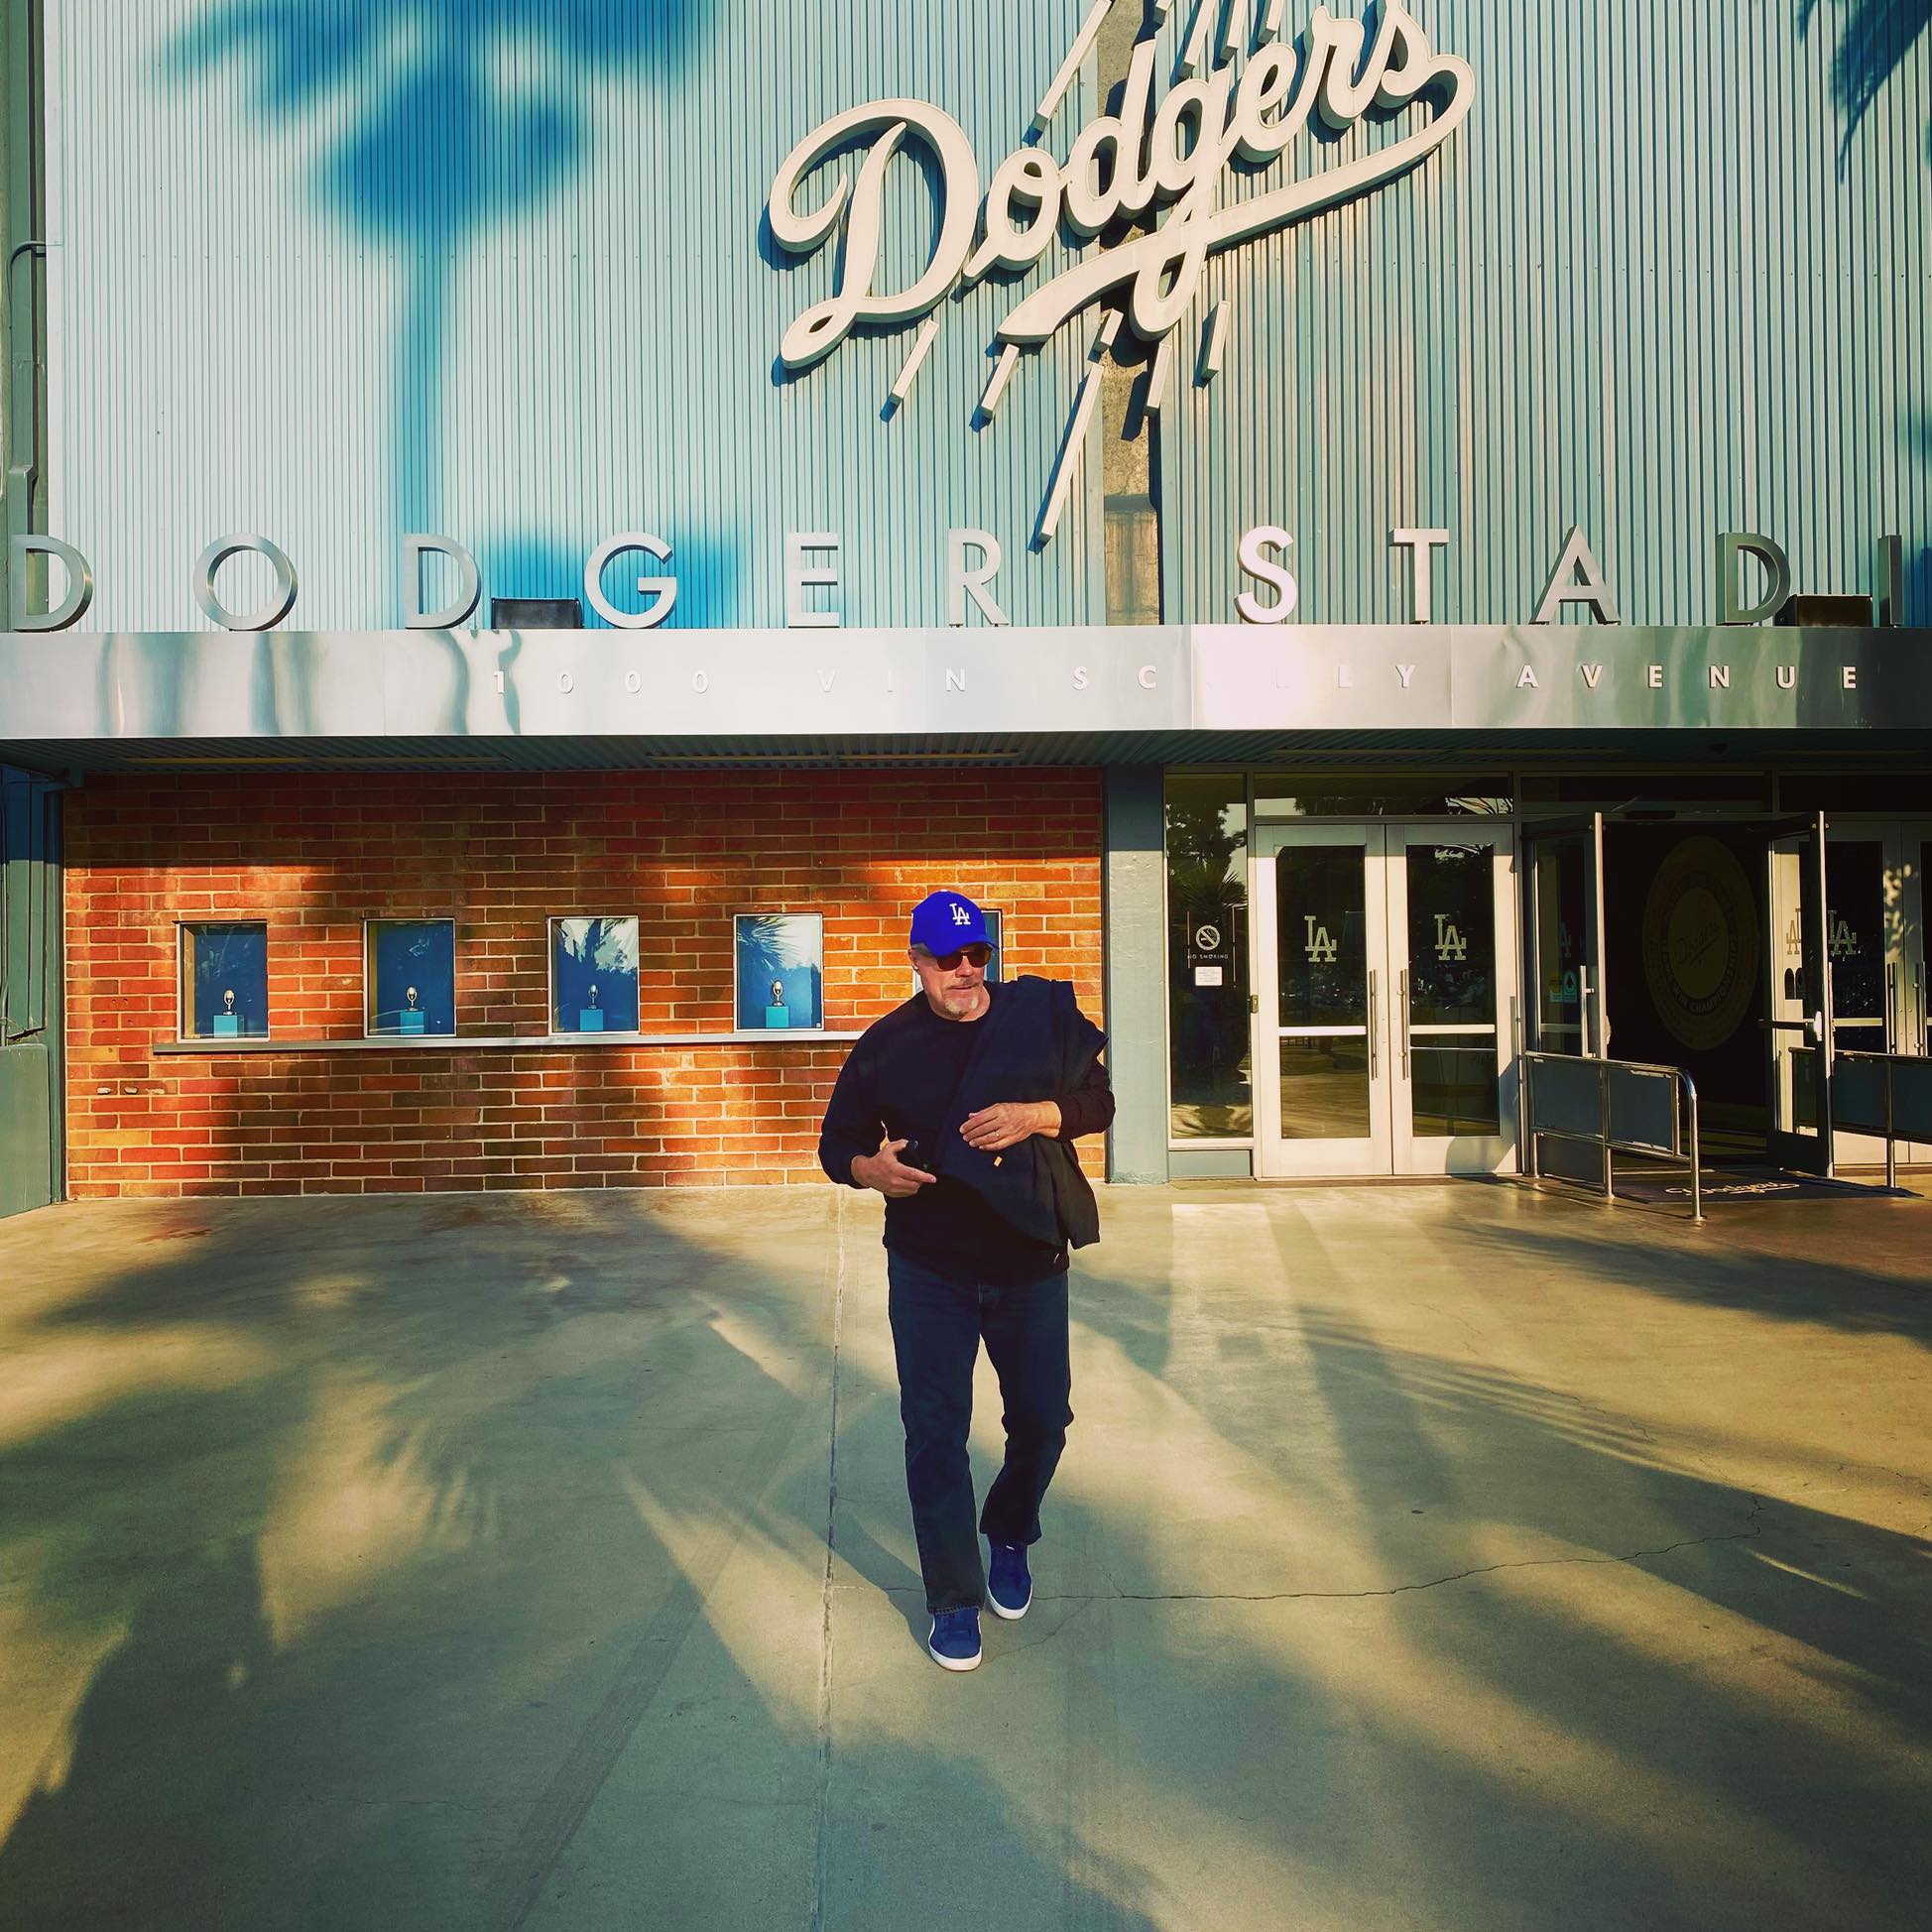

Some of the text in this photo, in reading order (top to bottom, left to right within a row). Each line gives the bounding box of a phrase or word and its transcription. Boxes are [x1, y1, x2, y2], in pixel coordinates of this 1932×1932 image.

[768, 0, 1476, 370] Dodgers
[11, 524, 1903, 632] DODGER STADI
[493, 664, 1857, 694] 1000 VIN SCLLY AVENUE
[949, 903, 971, 925] LA
[1434, 913, 1467, 961] LA
[1827, 909, 1858, 955] LA
[1304, 915, 1337, 962] LA
